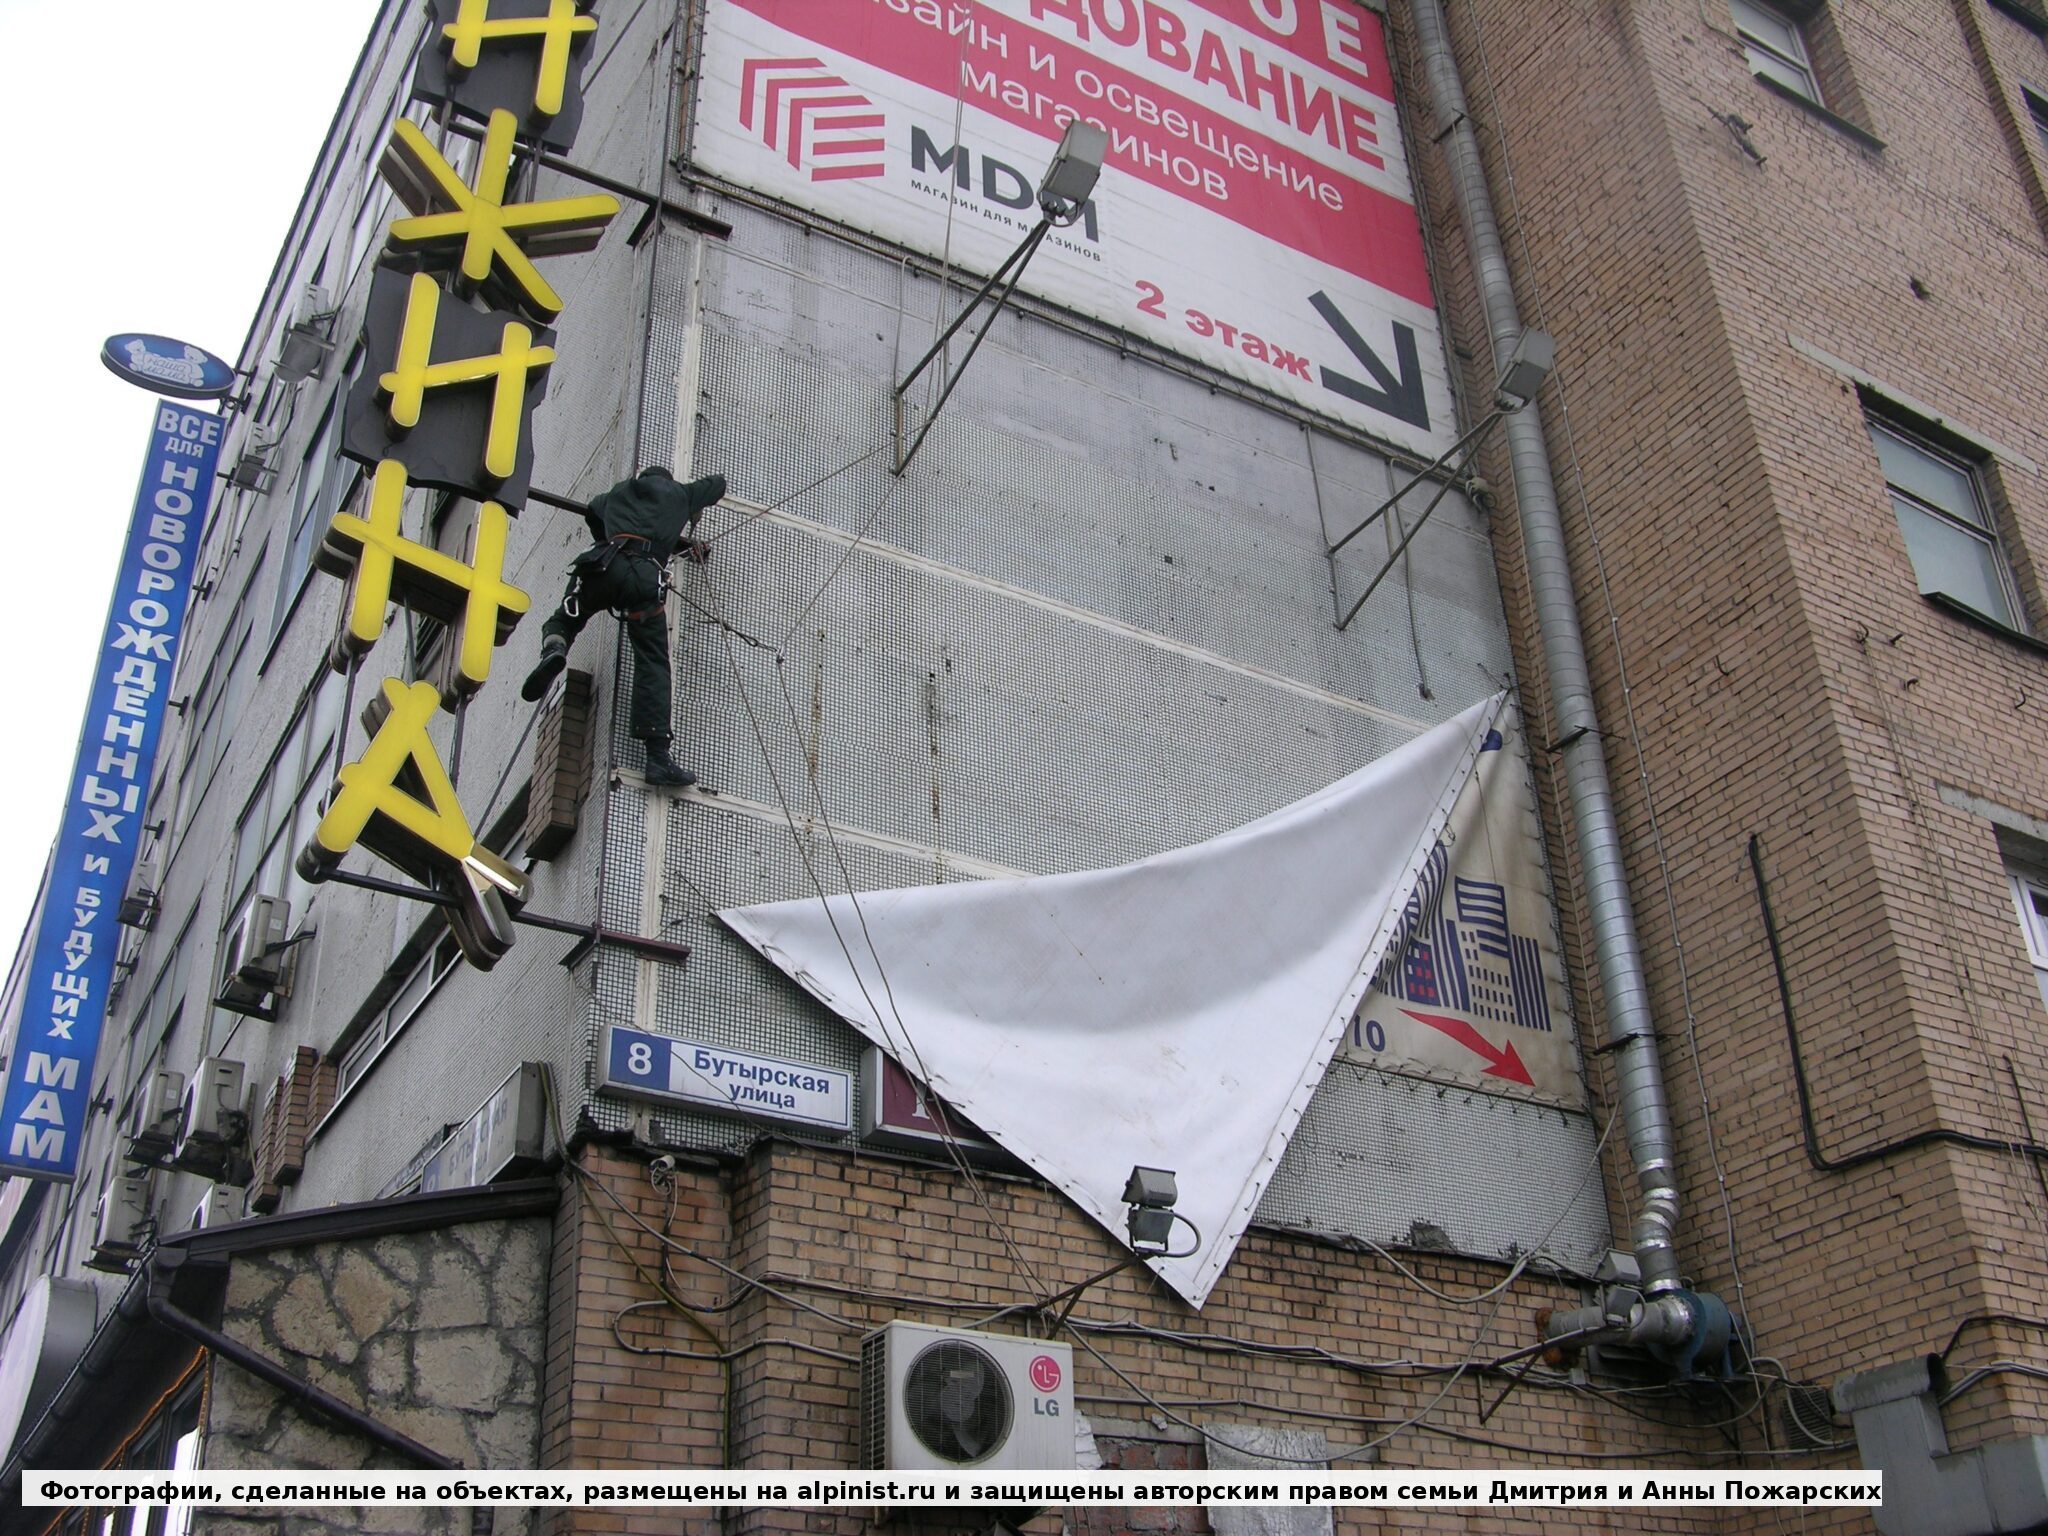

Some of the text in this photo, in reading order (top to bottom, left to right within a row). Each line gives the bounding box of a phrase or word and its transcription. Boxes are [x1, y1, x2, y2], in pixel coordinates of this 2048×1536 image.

[1030, 45, 1056, 80] и
[1075, 69, 1343, 212] освещение
[911, 180, 1101, 262] МАГАЗИН ДЛЯ МАЗИНОВ
[1135, 279, 1313, 382] 2 этаж
[158, 408, 220, 446] ВСЕ
[81, 459, 199, 844] НОВОРОЖДЕННЫХ
[47, 886, 102, 1040] БУДУЩИХ
[9, 1051, 80, 1162] МАМ
[627, 1042, 830, 1095] 8 Бутырская
[729, 1081, 796, 1109] улица
[1034, 1397, 1060, 1417] LG
